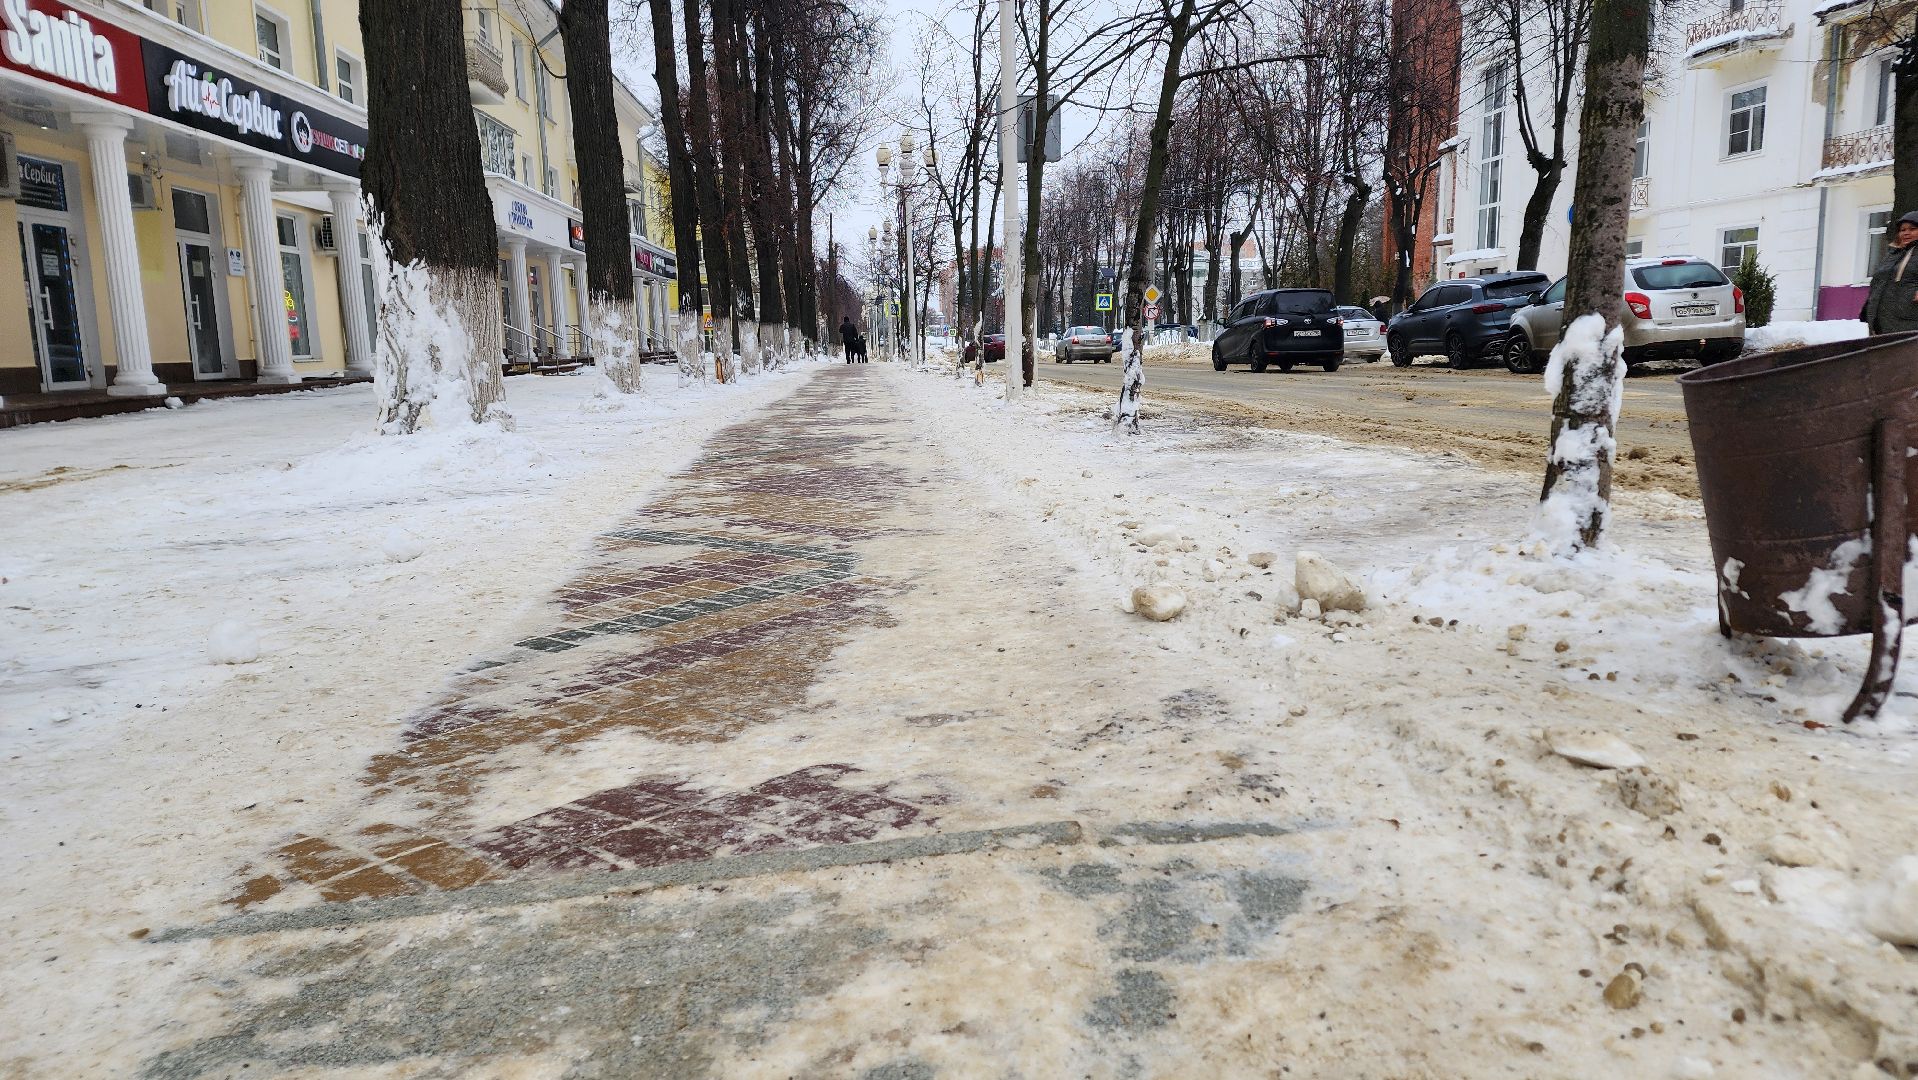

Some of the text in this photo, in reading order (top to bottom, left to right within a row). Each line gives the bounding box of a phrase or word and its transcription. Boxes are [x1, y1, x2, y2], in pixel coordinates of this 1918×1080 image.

[2, 0, 117, 94] Sanita
[166, 59, 283, 140] Ай Сервис
[24, 162, 57, 185] Сервис
